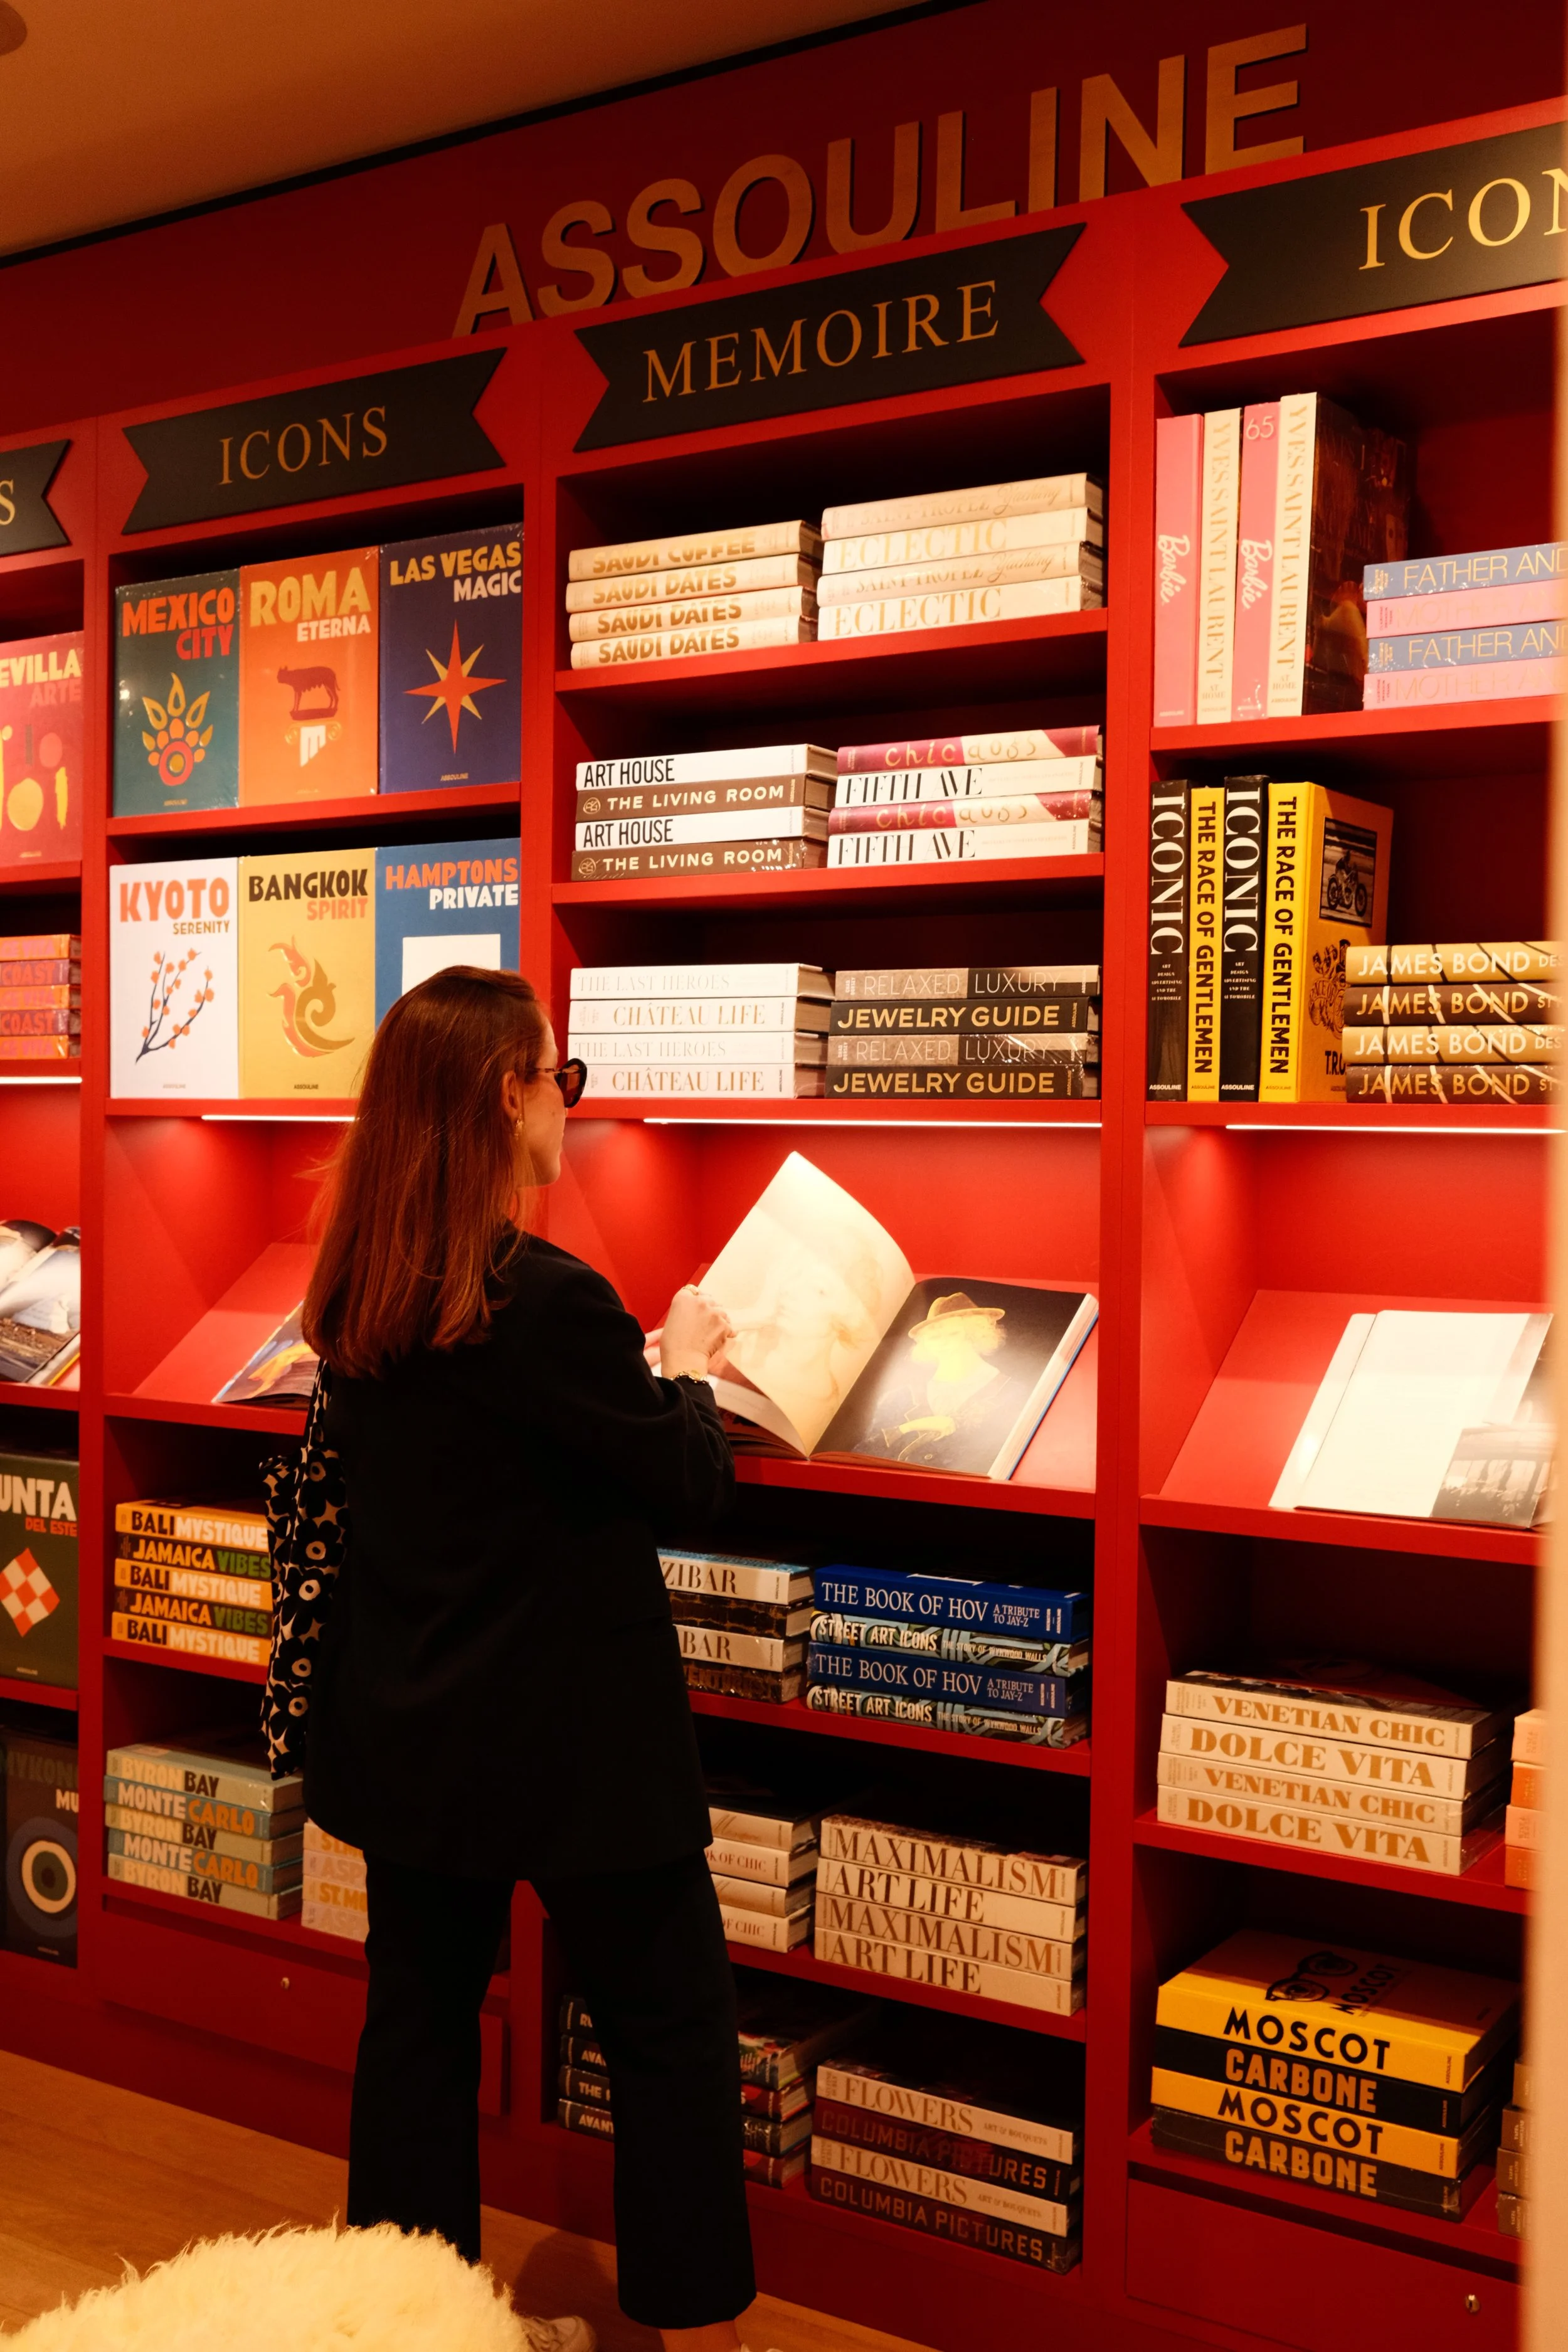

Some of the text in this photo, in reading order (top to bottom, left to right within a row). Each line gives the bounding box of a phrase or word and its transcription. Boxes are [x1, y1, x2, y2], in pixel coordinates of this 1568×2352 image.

[452, 23, 1306, 338] ASSOULINE
[642, 280, 999, 403] MEMOIRE
[220, 405, 388, 484] ICONS
[1246, 415, 1274, 440] 65
[839, 520, 1007, 569] ECLECTIC
[1276, 405, 1308, 670] YVES SAINT LAURENT
[390, 541, 522, 585] LAS VEGAS
[593, 547, 659, 574] SAUDI
[987, 551, 1056, 583] Yachting
[1157, 534, 1190, 605] Barbie
[1241, 539, 1273, 610] Barbie
[1404, 556, 1508, 590] FATHER
[250, 567, 371, 627] ROMA
[454, 569, 522, 602] MAGIC
[122, 587, 235, 637] MEXICO
[297, 615, 371, 642] ETERNA
[834, 588, 1002, 637] ECLECTIC
[176, 624, 234, 660] CITY
[598, 627, 740, 664] SAUDI DATES
[1409, 631, 1512, 663] FATHER
[30, 680, 81, 708] ARTE
[584, 758, 675, 788] ART HOUSE
[885, 741, 956, 767] chic
[607, 785, 785, 811] THE LIVING ROOM
[845, 768, 983, 804] FIFTH AVE
[583, 818, 673, 848] ART HOUSE
[876, 803, 946, 829] chic
[249, 869, 368, 902] BANGKOK
[386, 858, 518, 890] HAMPTONS
[1150, 794, 1185, 955] ICONIC
[1224, 788, 1260, 953] ICONIC
[120, 877, 230, 922] KYOTO
[307, 898, 368, 920] SPIRIT
[429, 884, 519, 910] PRIVATE
[173, 921, 230, 935] SERENITY
[1194, 802, 1216, 1073] THE RACE OF GENTLEMEN
[1270, 797, 1297, 1074] THE RACE OF GENTLEMEN
[2, 963, 55, 985] COAST
[578, 973, 730, 991] THE LAST HEROES
[1358, 952, 1443, 976] JAMES
[1453, 951, 1530, 973] BOND
[864, 972, 1061, 995] RELAXED LUXURY
[1, 1012, 55, 1035] COAST
[613, 1003, 711, 1026] CHÂTEAU
[718, 1004, 766, 1025] LIFE
[838, 1005, 1059, 1029] JEWELRY GUIDE
[834, 1073, 1054, 1093] JEWELRY GUIDE
[26, 1517, 77, 1537] DEL ESTE
[132, 1511, 268, 1552] BALI MYSTIQUE
[133, 1539, 271, 1578] JAMAICA VIBES
[130, 1565, 262, 1607] BALI MYSTIQUE
[822, 1582, 988, 1621] THE BOOK OF HOV
[993, 1604, 1040, 1619] A TRIBUTE
[993, 1613, 1029, 1627] TO JAY-Z
[683, 1631, 731, 1661] BAR
[819, 1618, 867, 1641] STREET
[870, 1626, 896, 1645] ART
[899, 1630, 938, 1651] ICONS
[943, 1640, 954, 1650] THE
[956, 1643, 976, 1651] STORY
[989, 1648, 1022, 1659] WYNWOOD
[1025, 1652, 1047, 1662] WALLS
[815, 1654, 982, 1695] THE BOOK OF HOV
[815, 1689, 933, 1723] STREET ART ICONS
[1212, 1695, 1362, 1735] VENETIAN
[1369, 1720, 1444, 1747] CHIC
[123, 1756, 220, 1798] BYRON BAY
[1190, 1727, 1326, 1771] DOLCE
[1338, 1749, 1435, 1788] VITA
[117, 1782, 255, 1836] MONTE CARLO
[1204, 1767, 1435, 1825] VENETIAN CHIC
[122, 1810, 218, 1850] BYRON BAY
[719, 1851, 734, 1865] OF
[736, 1856, 766, 1872] CHIC
[833, 1827, 1059, 1900] MAXIMALISM
[833, 1865, 985, 1923] ART LIFE
[829, 1897, 1056, 1975] MAXIMALISM
[1330, 1963, 1402, 2015] MOSCOT
[1223, 2007, 1390, 2070] MOSCOT
[579, 2082, 601, 2099] THE
[1226, 2048, 1377, 2114] CARBONE
[845, 2077, 1047, 2147] FLOWERS ART BOUQUETS
[1218, 2088, 1383, 2154] MOSCOT
[821, 2109, 1047, 2190] COLUMBIA PICTURES
[1226, 2130, 1377, 2198] CARBONE
[821, 2176, 1043, 2262] COLUMBIA PICTURES
